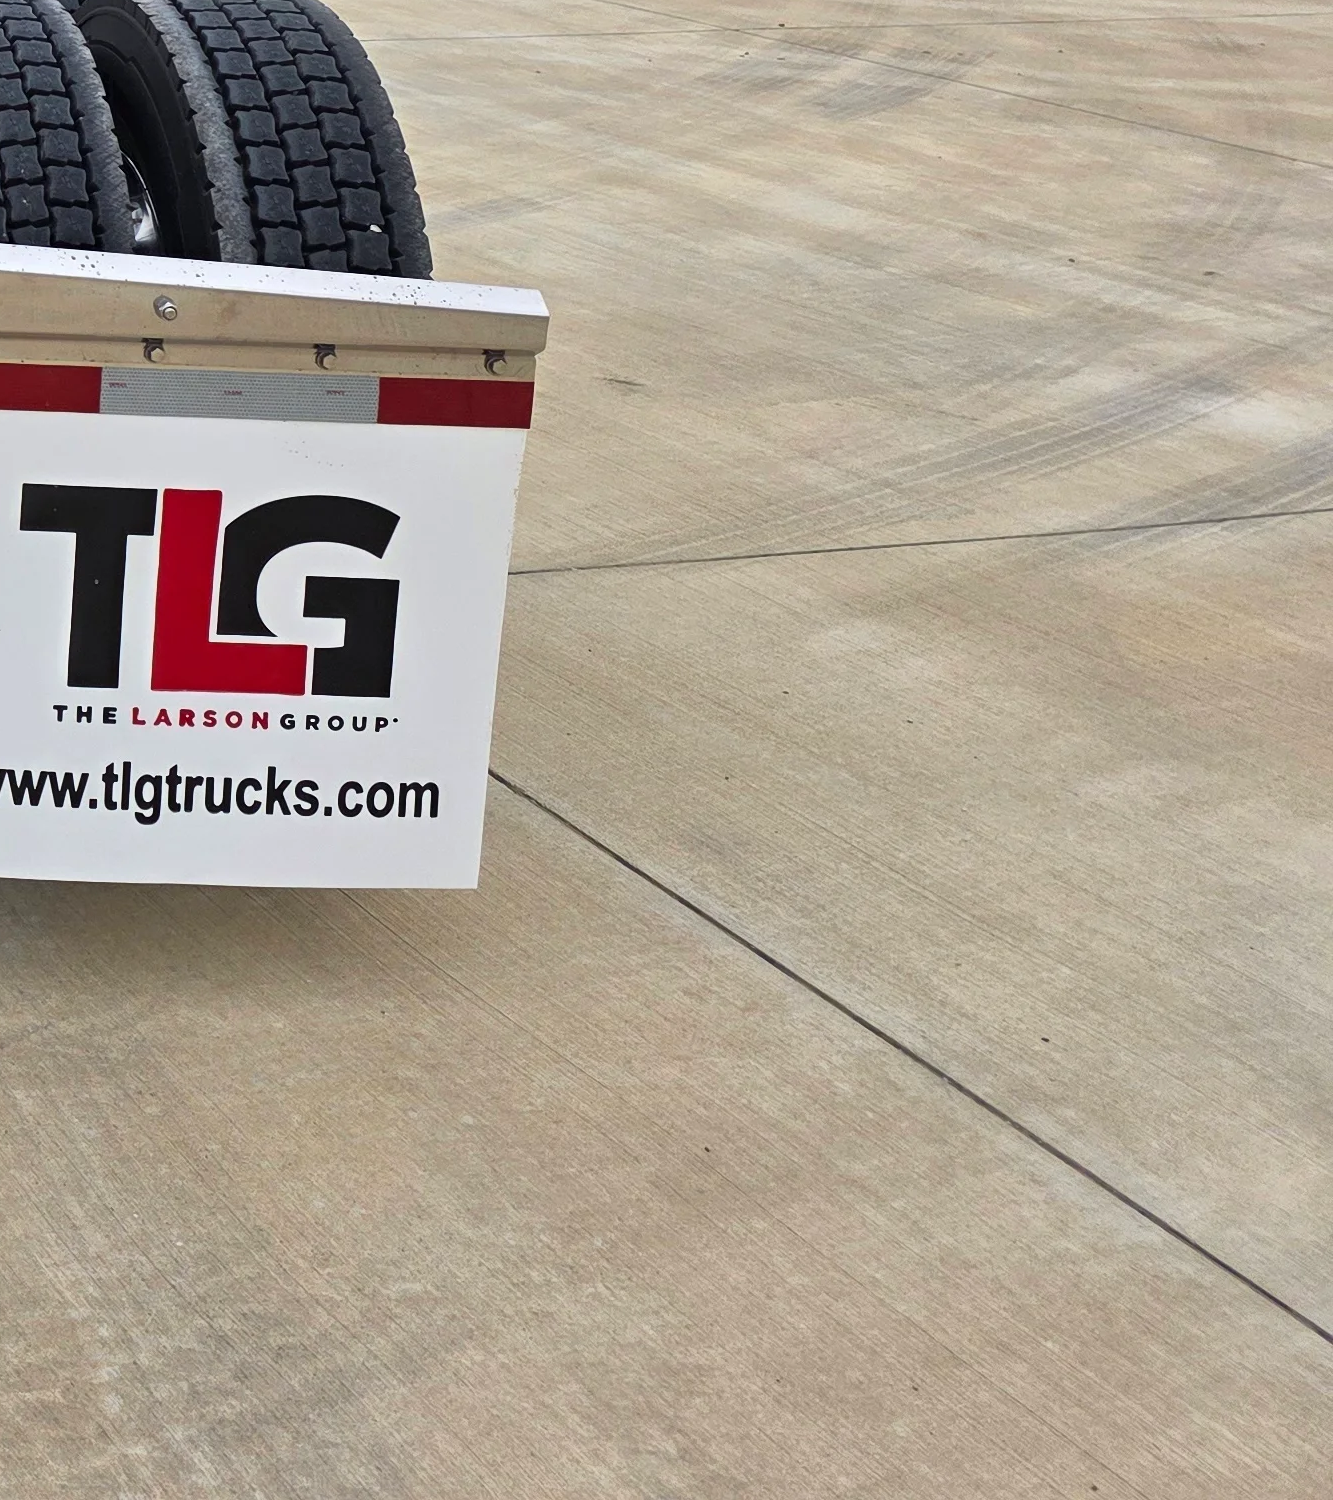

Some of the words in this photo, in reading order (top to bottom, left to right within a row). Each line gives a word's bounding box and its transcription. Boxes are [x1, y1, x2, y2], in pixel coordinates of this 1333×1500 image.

[19, 482, 401, 699] TLG
[52, 704, 118, 725] THE
[132, 706, 269, 730] LARSON
[279, 713, 389, 733] GROUP
